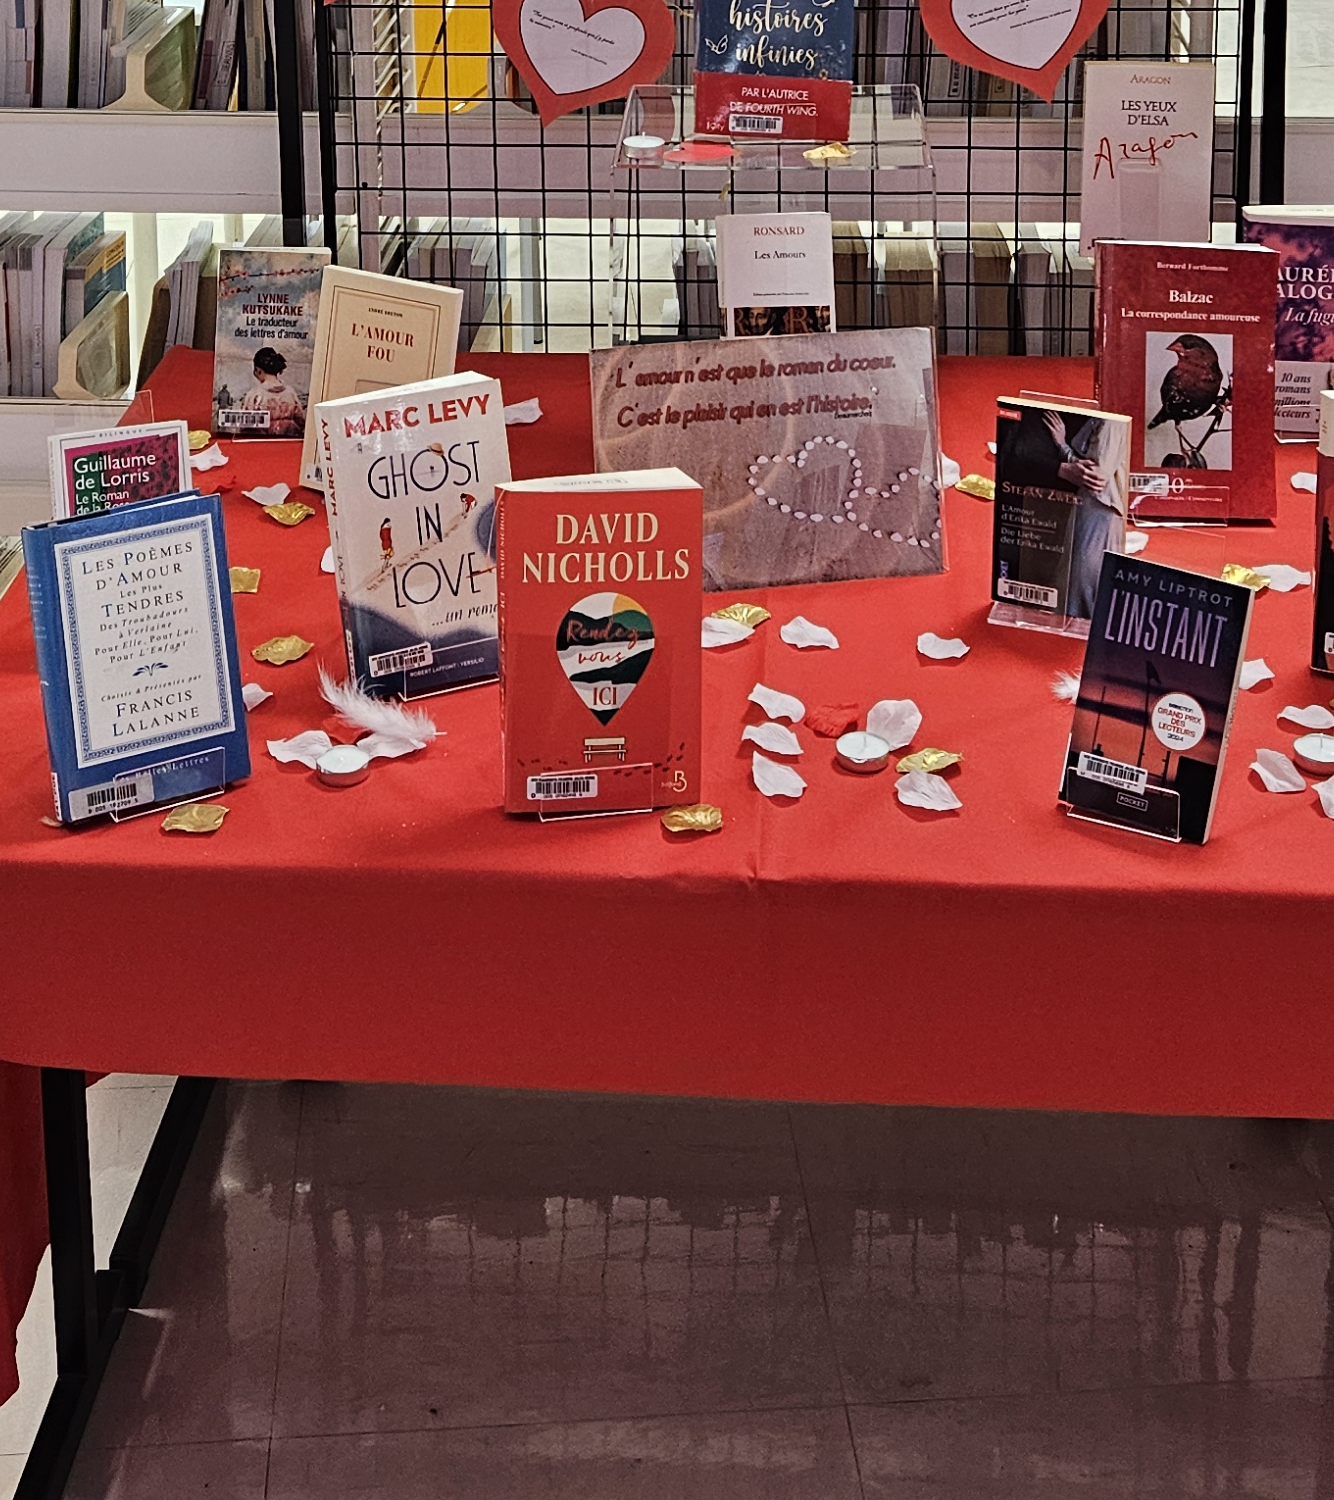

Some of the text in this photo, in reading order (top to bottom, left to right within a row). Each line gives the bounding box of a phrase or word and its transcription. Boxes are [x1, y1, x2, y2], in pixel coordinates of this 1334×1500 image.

[736, 35, 818, 71] infinies
[741, 87, 809, 101] PAR L'AUTRICE
[729, 101, 785, 114] DE FOURTH
[1122, 100, 1177, 112] LES YEUX
[1127, 114, 1169, 126] D'ELSA
[753, 226, 805, 236] RONSARD
[754, 250, 806, 260] Les Amours
[1157, 261, 1229, 272] Bernard Forthomme
[257, 293, 289, 304] LYNNE
[1169, 290, 1213, 304] Balzac
[242, 303, 303, 316] KUTSUKAKE
[1121, 308, 1260, 323] La correspondance amoureuse
[1285, 307, 1304, 322] La
[246, 316, 298, 327] Le traducteur
[234, 327, 309, 339] des lettres d'amour
[351, 323, 414, 348] L'AMOUR
[367, 345, 395, 363] FOU
[726, 366, 757, 385] que
[759, 360, 775, 377] le
[777, 362, 824, 376] roman
[827, 353, 848, 373] du
[1281, 372, 1312, 383] 10 ans
[1275, 385, 1311, 394] romans
[344, 394, 491, 439] MARC LEVY
[617, 404, 662, 428] C'est
[665, 406, 681, 424] le
[682, 403, 727, 429] plaisir
[730, 402, 754, 424] qui
[756, 402, 779, 418] en
[778, 399, 805, 416] est
[1274, 408, 1311, 419] lecteurs
[99, 429, 142, 438] BILINGUE
[74, 454, 156, 474] Guillaume
[321, 419, 338, 516] MARC LEVY
[367, 440, 481, 500] GHOST
[75, 468, 150, 490] de Lorris
[76, 491, 129, 505] Le Roman
[416, 503, 443, 546] IN
[556, 512, 659, 544] DAVID
[1032, 519, 1057, 529] Ewald
[1001, 527, 1041, 541] Die Liebe
[1000, 535, 1064, 553] der Ewald
[81, 541, 194, 575] LES POÈMES
[522, 549, 690, 583] NICHOLLS
[96, 563, 183, 591] D'AMOUR
[392, 552, 481, 609] LOVE
[120, 584, 163, 598] Les Plus
[1115, 569, 1233, 608] AMY LIPTROT
[101, 590, 185, 618] TENDRES
[100, 607, 189, 632] Des Troubadours
[128, 621, 172, 637] Verlaine
[566, 620, 639, 649] Rendez
[1104, 589, 1229, 668] L'INSTANT
[95, 633, 173, 656] Pour Pour
[110, 640, 188, 664] Pour L'Enfant
[578, 651, 625, 665] vous
[409, 670, 430, 678] ROBERT
[101, 691, 133, 702] Choisis
[116, 689, 193, 718] FRANCIS
[592, 687, 617, 706] ICI
[112, 707, 201, 737] LALANNE
[1157, 707, 1201, 726] GRAND PRIX
[1170, 718, 1186, 728] DES
[1158, 723, 1195, 738] LECTEURS
[171, 754, 210, 770] Lettres
[1119, 795, 1145, 808] POCKET
